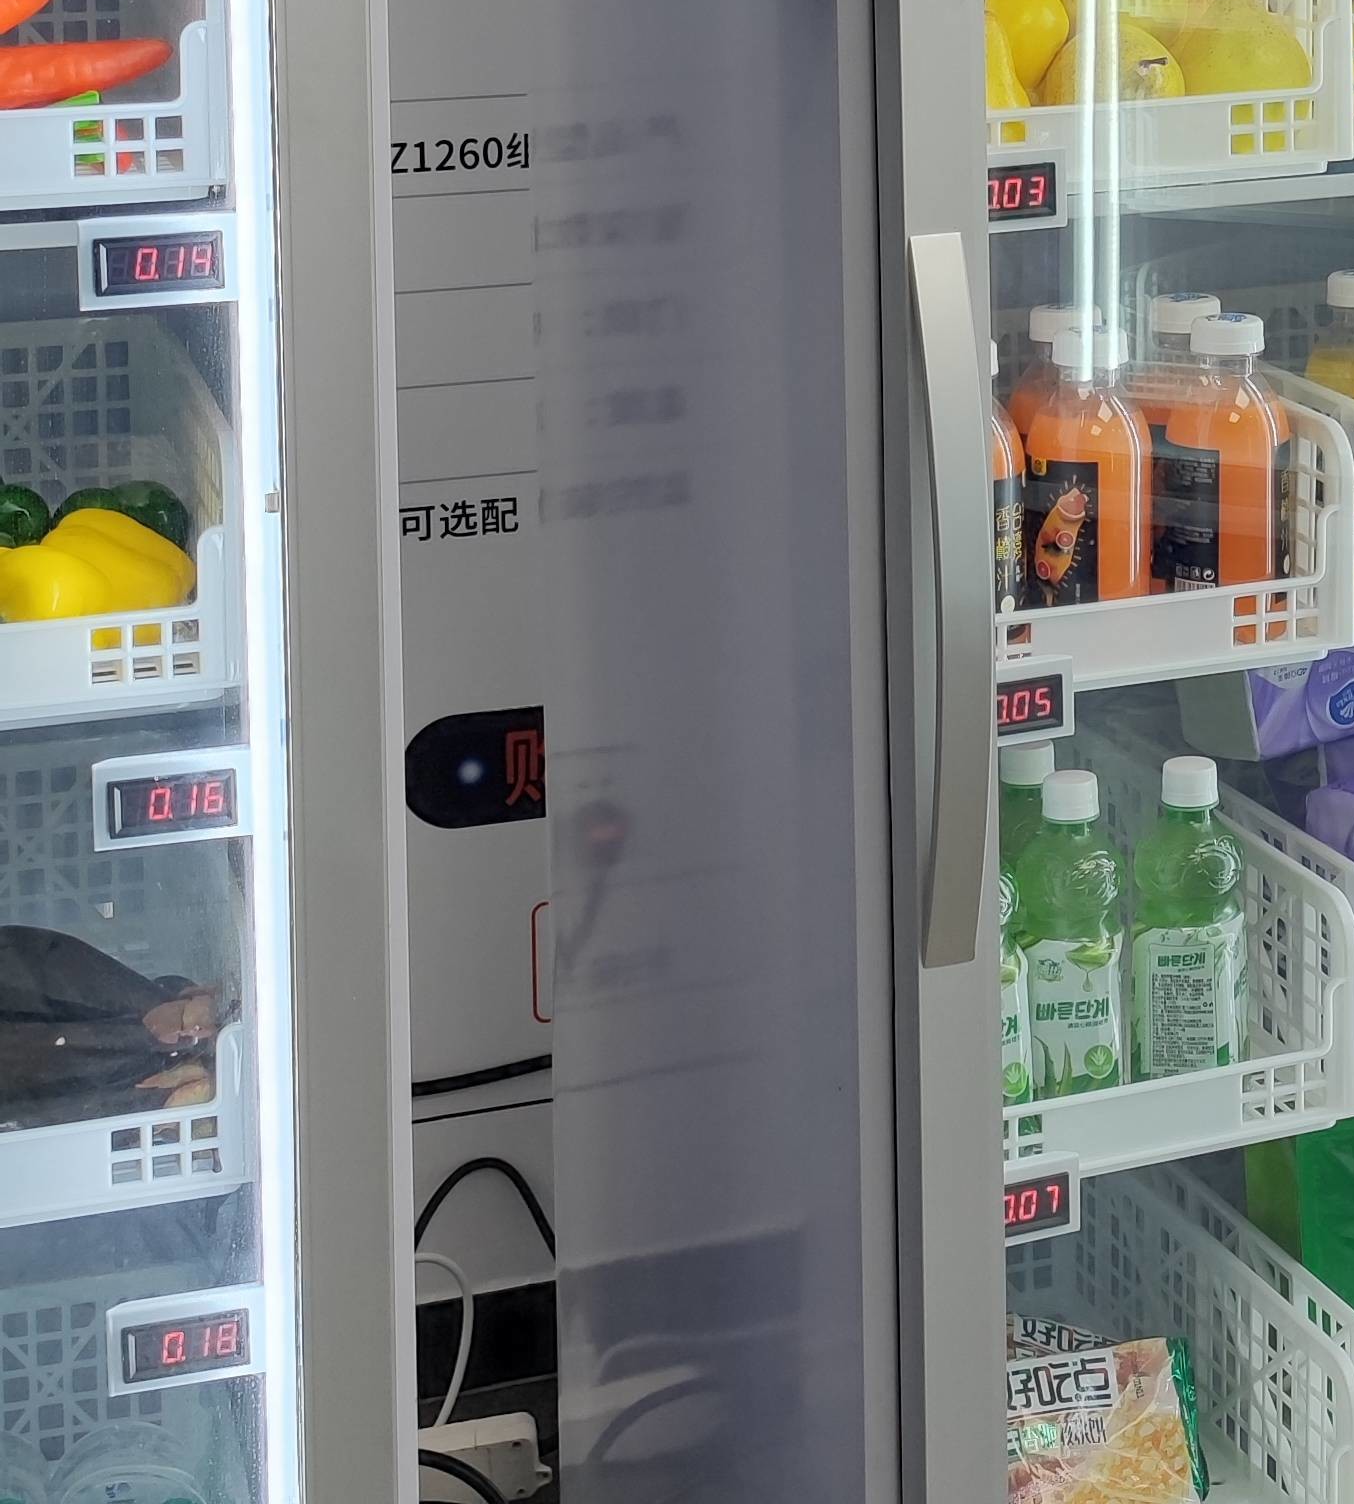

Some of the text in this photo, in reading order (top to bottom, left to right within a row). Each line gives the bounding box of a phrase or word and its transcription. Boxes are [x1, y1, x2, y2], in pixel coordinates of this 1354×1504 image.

[134, 244, 212, 282] 0.14
[399, 497, 518, 541] 可选配
[148, 781, 225, 822] 0.16
[161, 1322, 239, 1366] 0.18
